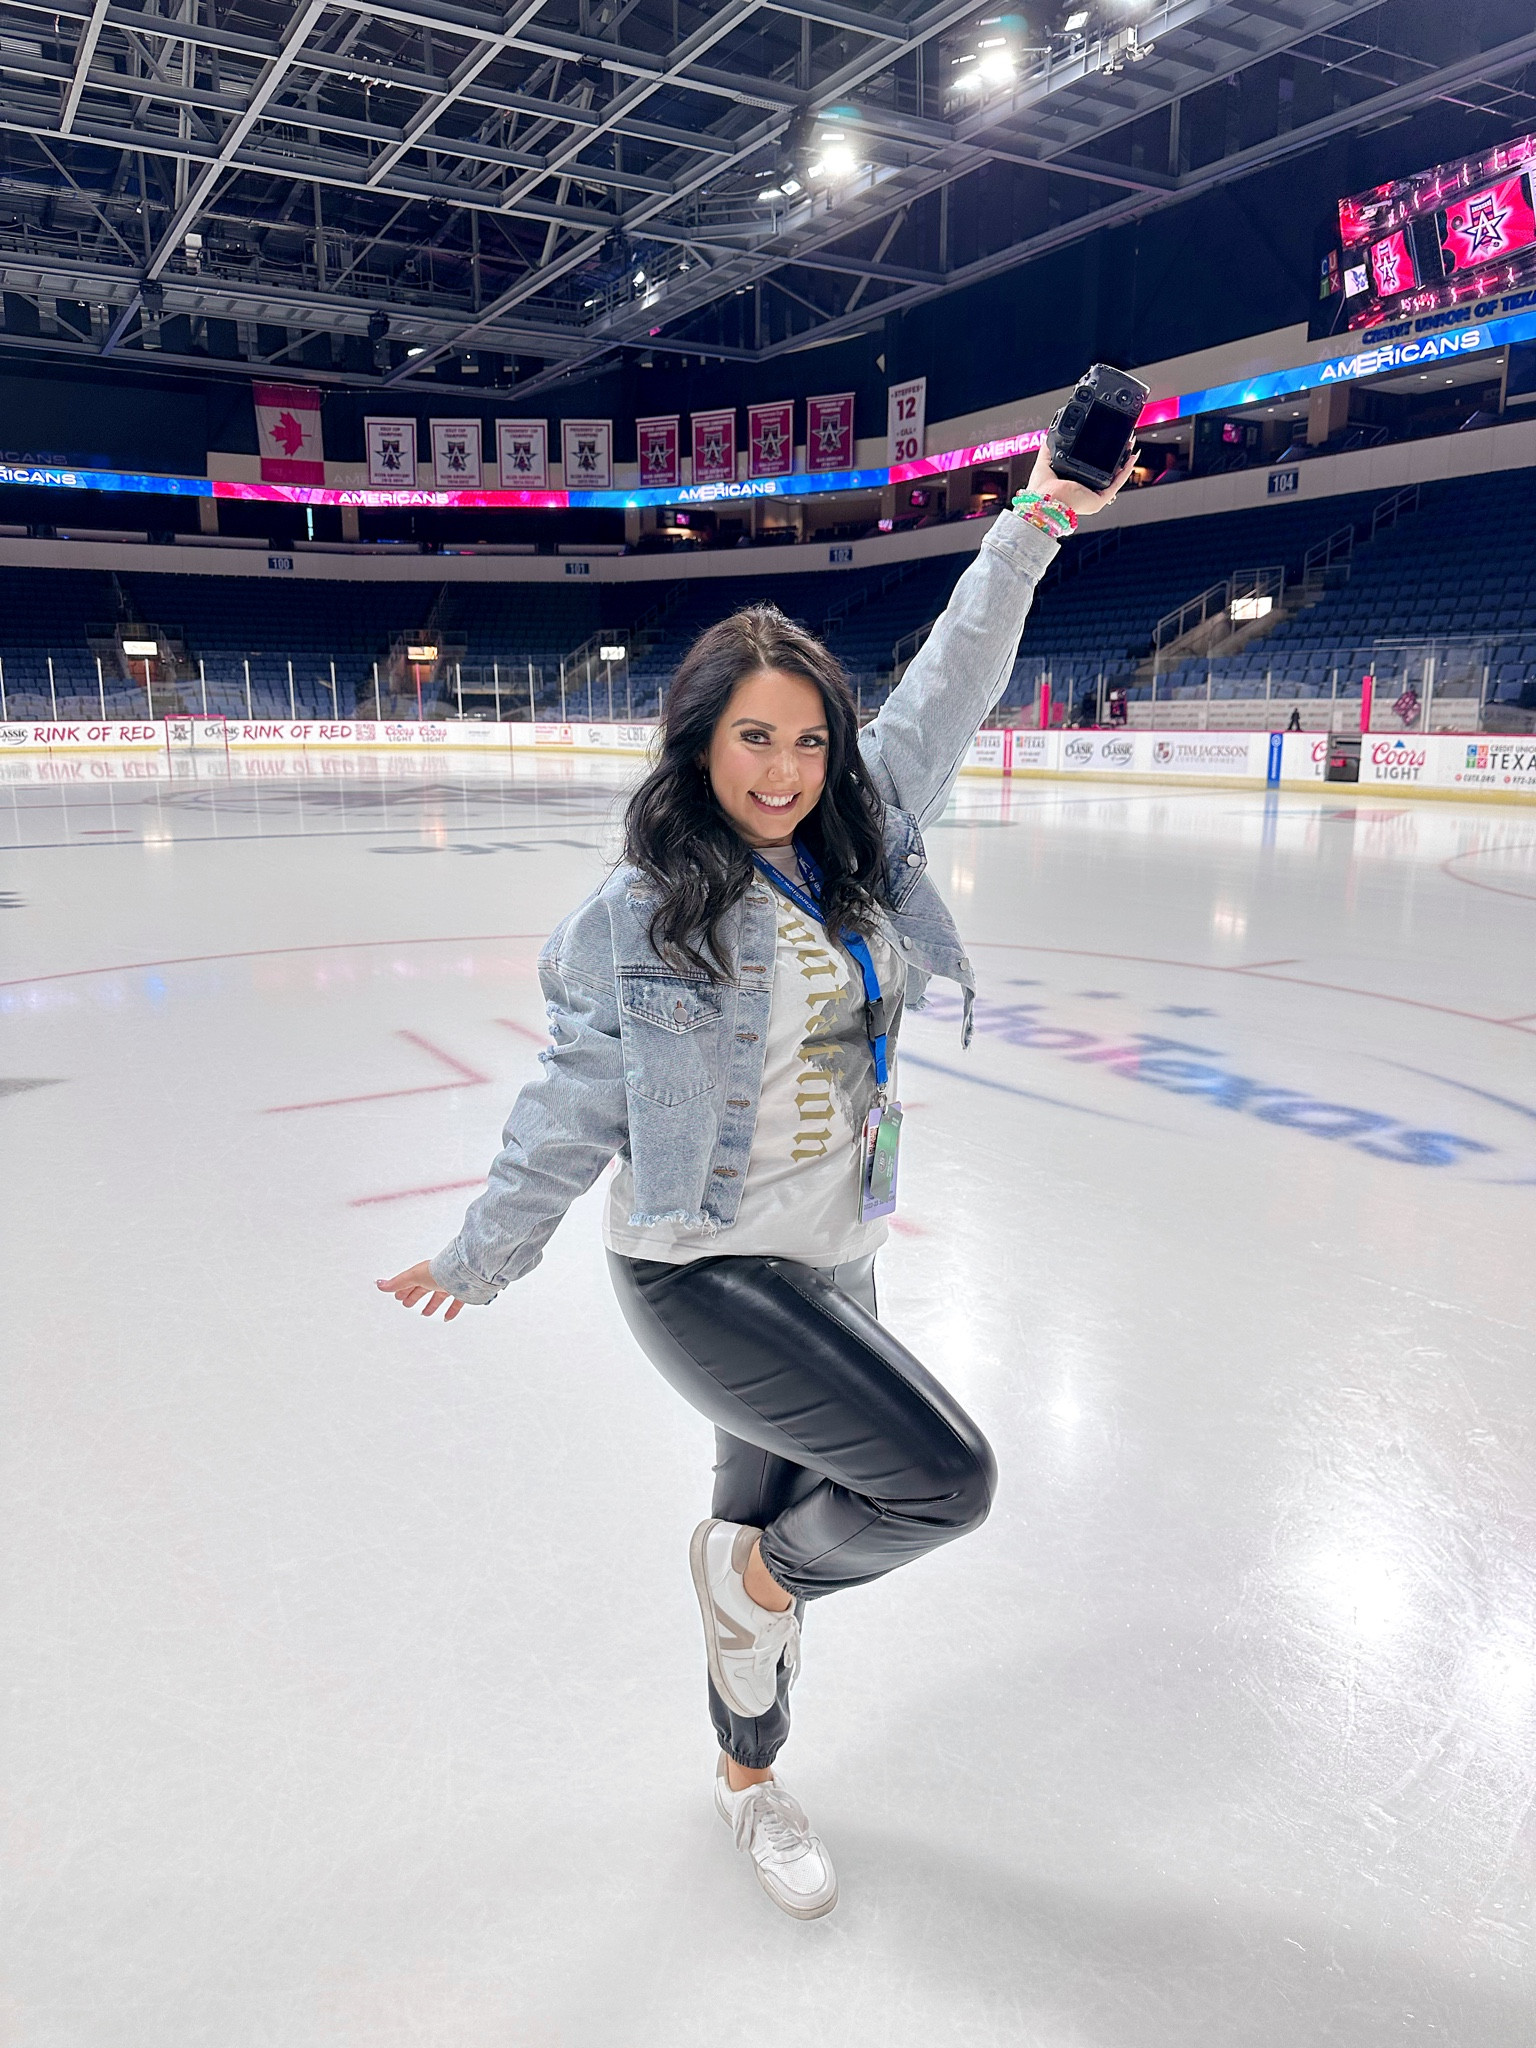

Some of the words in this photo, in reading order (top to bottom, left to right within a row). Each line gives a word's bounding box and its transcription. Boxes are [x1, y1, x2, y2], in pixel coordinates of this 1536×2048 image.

[1362, 321, 1412, 344] CREDIT
[1415, 306, 1471, 332] UNION
[1474, 299, 1498, 318] OF
[1319, 330, 1481, 381] AMERICANS
[897, 397, 916, 421] 12
[895, 438, 918, 462] 30
[972, 433, 1048, 462] AMERICAN
[1273, 474, 1294, 492] 104
[678, 482, 776, 500] AMERICANS
[338, 493, 450, 505] AMERICANS
[831, 549, 850, 561] 102
[272, 558, 291, 570] 100
[569, 563, 587, 574] 101
[33, 727, 80, 743] RINK
[87, 727, 112, 742] OF
[120, 726, 155, 742] RED
[243, 725, 285, 740] RINK
[291, 725, 314, 740] OF
[319, 725, 352, 740] RED
[385, 725, 414, 736] Coors
[419, 725, 447, 736] Coors
[1102, 742, 1133, 758] CLASSIC
[1177, 745, 1196, 756] TIM
[1198, 745, 1249, 757] JACKSON
[1372, 741, 1426, 767] Coors
[1490, 744, 1514, 753] CREDIT
[1515, 744, 1536, 754] UNIO
[1376, 766, 1420, 781] LIGHT
